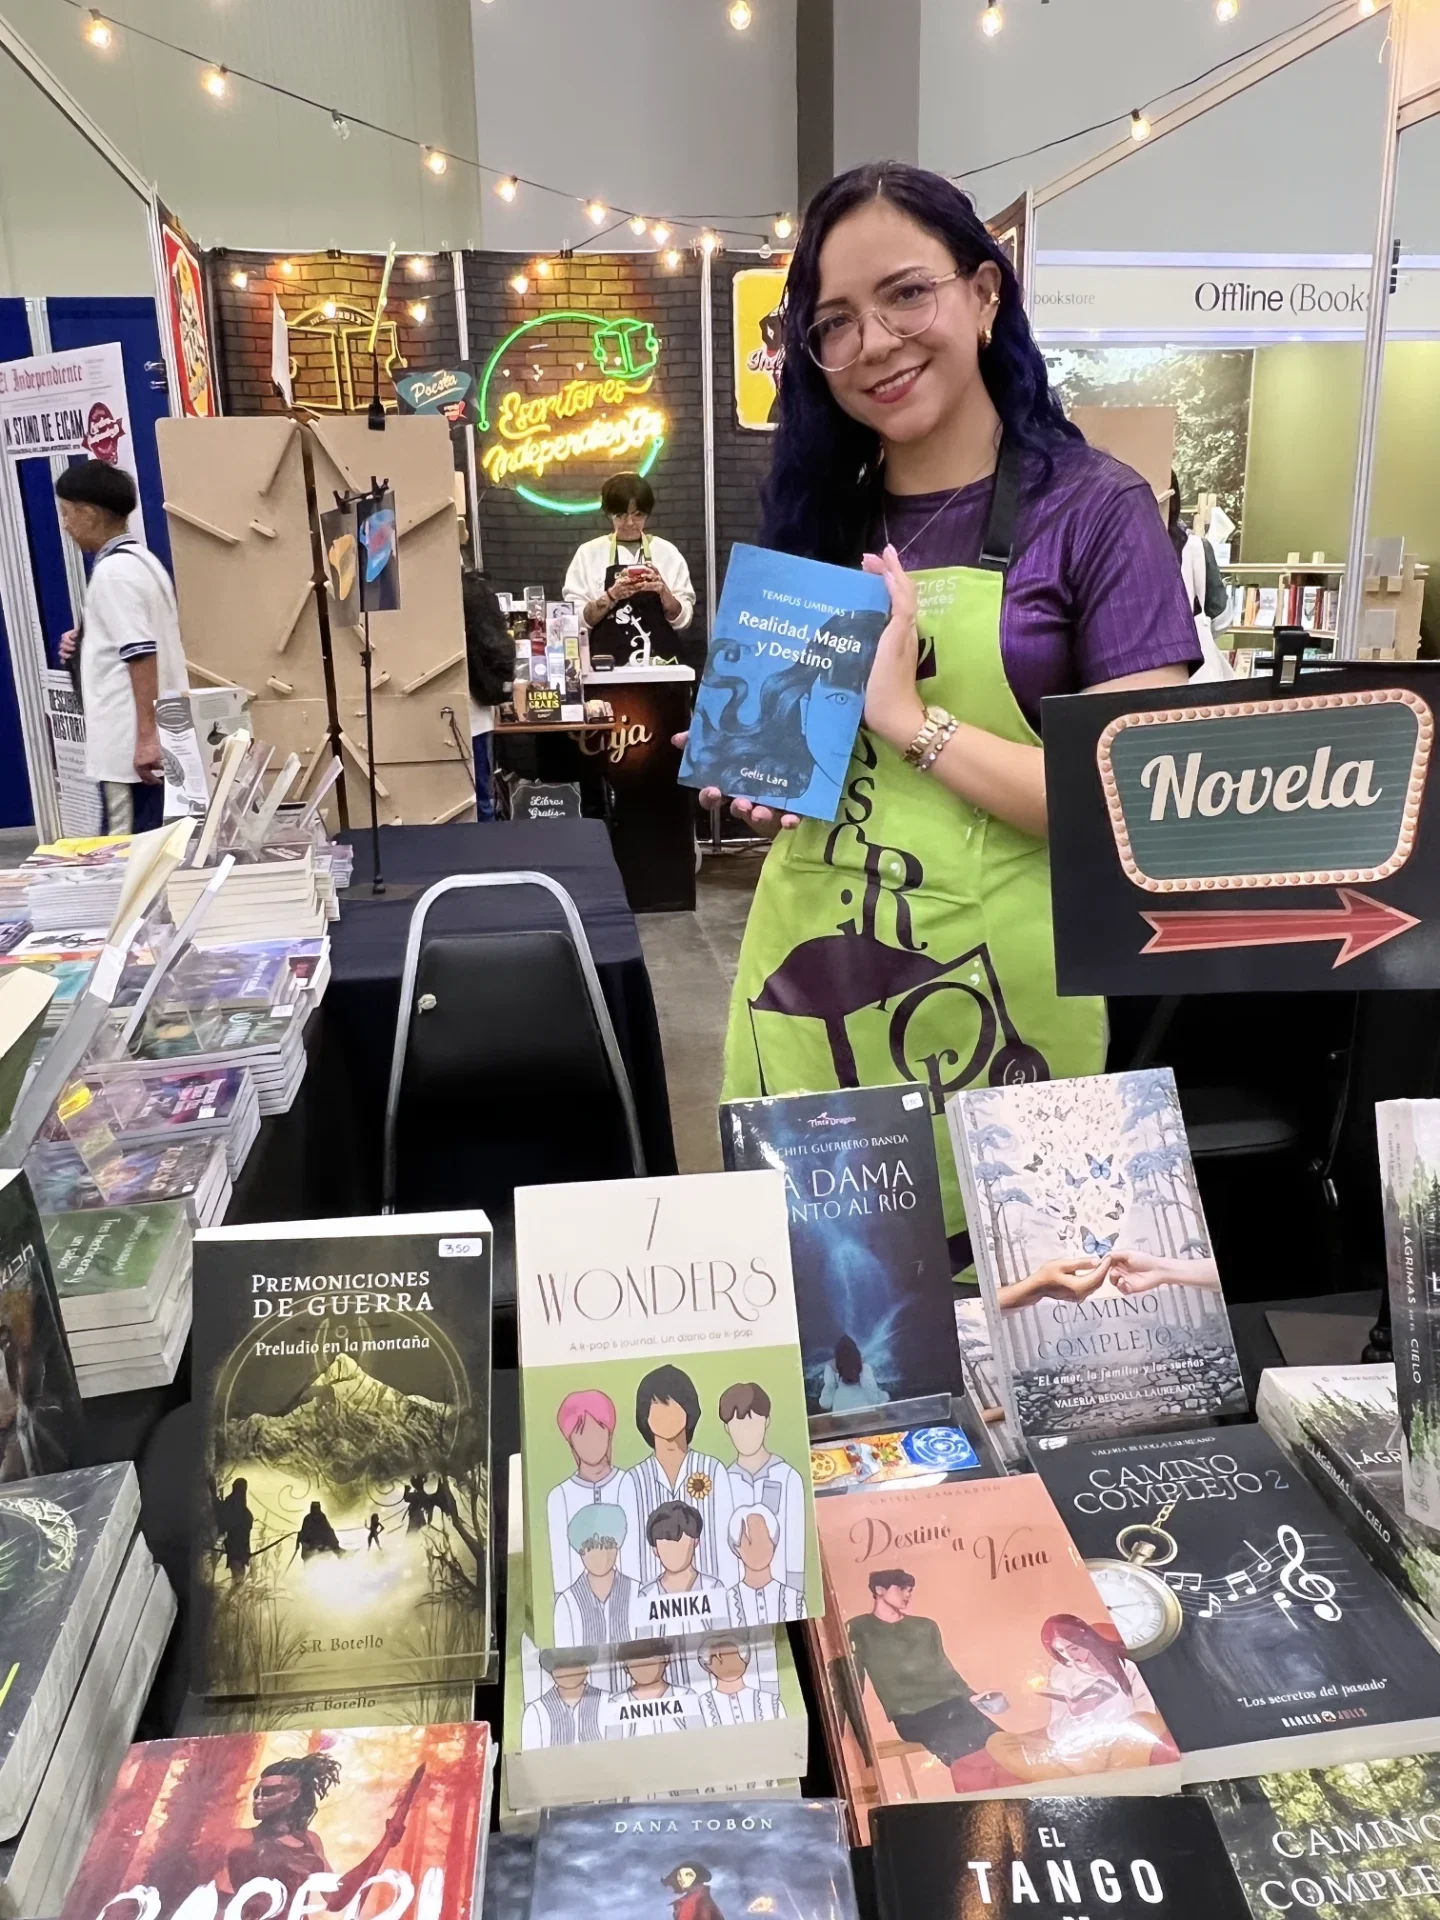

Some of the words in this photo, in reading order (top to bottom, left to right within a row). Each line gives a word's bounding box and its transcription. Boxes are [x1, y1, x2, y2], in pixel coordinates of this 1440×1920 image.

[1194, 281, 1284, 312] Offline
[12, 363, 83, 392] Independiente
[499, 375, 654, 440] Escritores
[41, 413, 55, 442] DE
[762, 589, 802, 607] TEMPUS
[803, 600, 846, 617] UMBRAS
[738, 611, 811, 643] Realidad,
[813, 630, 862, 654] Magia
[754, 641, 768, 657] y
[768, 642, 833, 670] Destino
[740, 767, 765, 781] Gelis
[766, 771, 789, 788] Lara
[1140, 745, 1383, 821] Novela
[811, 1137, 869, 1153] GUERRERO
[871, 1133, 909, 1147] BANDA
[784, 1172, 801, 1200] A
[811, 1159, 914, 1198] DAMA
[791, 1201, 841, 1224] NTO
[848, 1198, 873, 1216] AL
[878, 1189, 917, 1212] RÍO
[646, 1196, 661, 1251] 7
[444, 1243, 471, 1255] 350
[251, 1270, 431, 1293] PREMONICIONES
[536, 1256, 777, 1326] WONDERS
[253, 1298, 294, 1319] DE
[308, 1291, 435, 1317] GUERRA
[1052, 1294, 1160, 1325] CAMINO
[255, 1338, 320, 1356] Preludio
[322, 1341, 341, 1354] en
[344, 1338, 359, 1353] la
[361, 1335, 431, 1352] montaña
[660, 1335, 676, 1344] Un
[1037, 1326, 1173, 1360] COMPLEJO
[1086, 1370, 1098, 1381] la
[1100, 1365, 1139, 1382] familia
[1152, 1361, 1167, 1372] los
[1410, 1338, 1422, 1384] CIELO
[1054, 1396, 1097, 1409] VALERIA
[1098, 1391, 1143, 1404] BEDOLLA
[1088, 1454, 1239, 1490] CAMINO
[1345, 1449, 1402, 1470] LÁGR
[1073, 1472, 1263, 1514] COMPLEJO
[1264, 1469, 1290, 1490] 2
[1365, 1509, 1391, 1543] CIELO
[850, 1517, 951, 1564] Destino
[952, 1535, 965, 1552] a
[973, 1526, 1052, 1580] Viena
[649, 1595, 712, 1621] ANNIKA
[330, 1634, 384, 1651] Botello
[1268, 1690, 1317, 1705] secretos
[1320, 1684, 1339, 1698] del
[619, 1699, 684, 1721] ANNIKA
[614, 1820, 678, 1834] DANA
[691, 1815, 774, 1832] TOBÓN
[1037, 1827, 1066, 1848] EL
[1271, 1813, 1440, 1859] CAMINO
[968, 1858, 1165, 1905] TANGO
[1260, 1864, 1440, 1910] COMPLE
